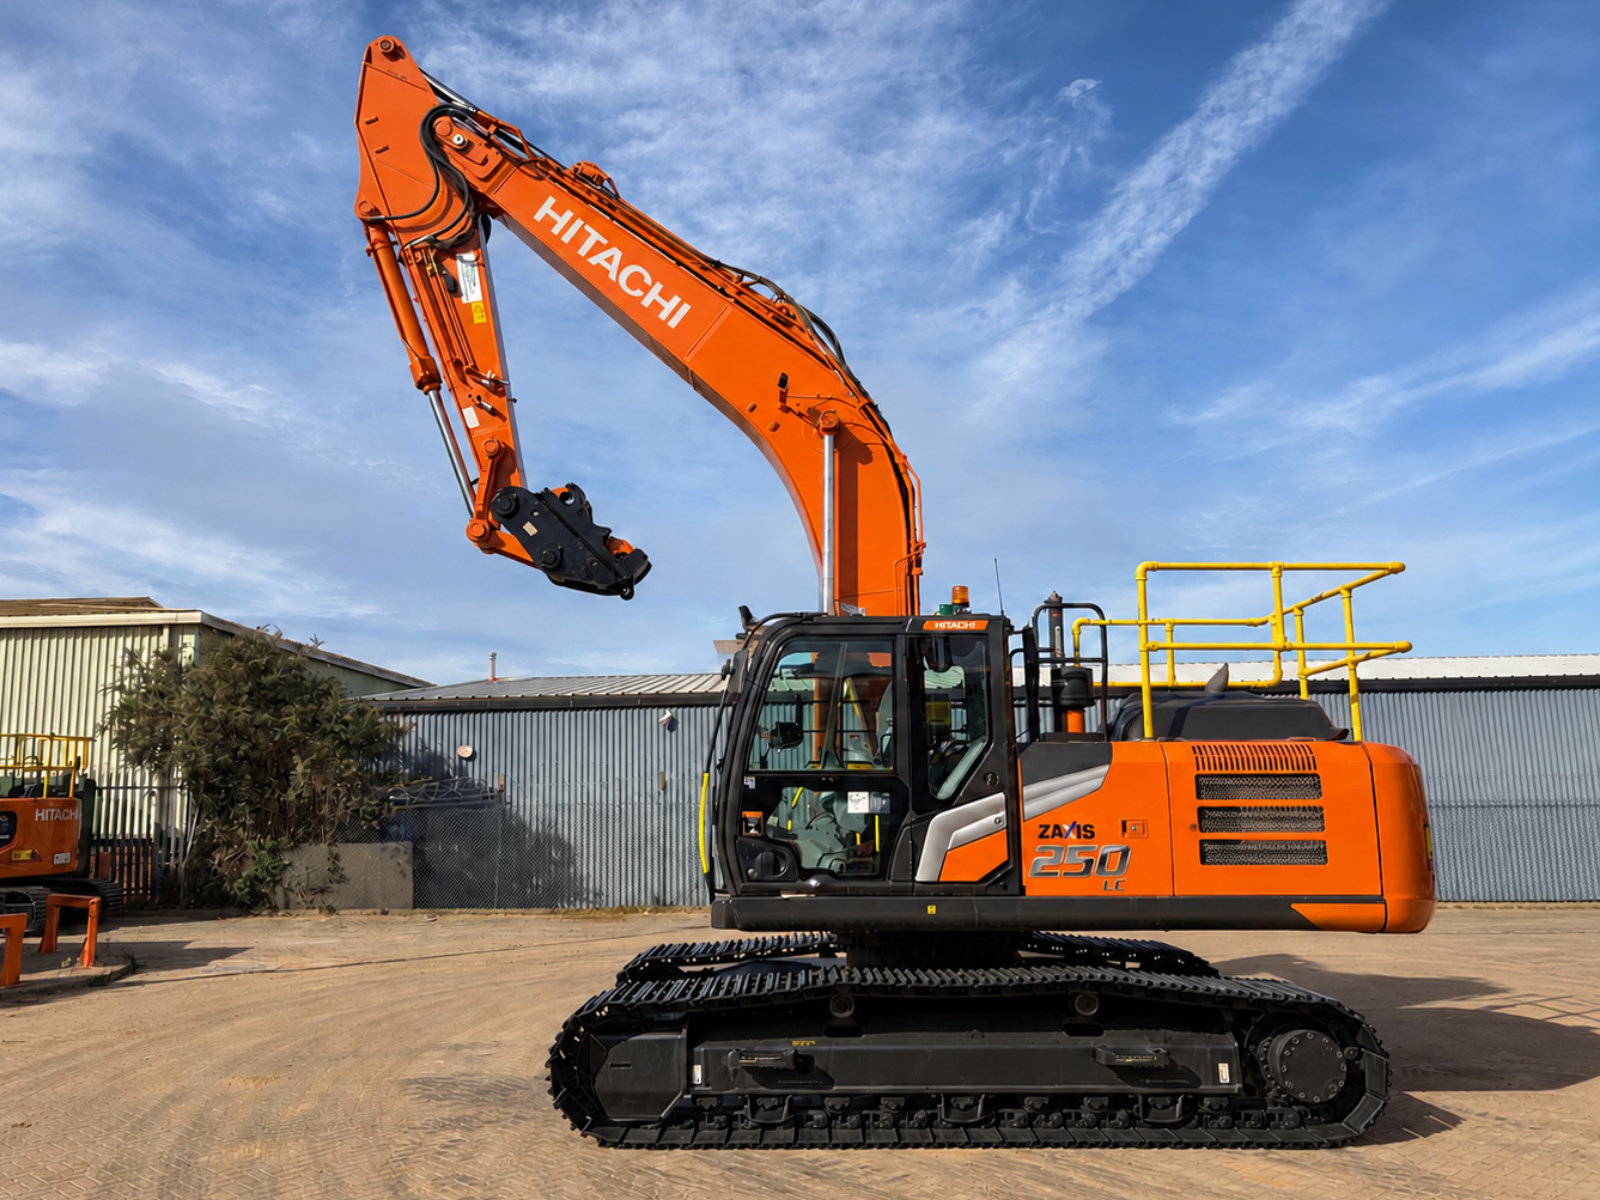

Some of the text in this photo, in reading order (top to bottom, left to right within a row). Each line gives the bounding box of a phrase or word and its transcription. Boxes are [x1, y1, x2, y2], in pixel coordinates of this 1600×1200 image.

[533, 195, 692, 329] HITACHI
[935, 621, 976, 630] HITACHI
[35, 808, 81, 821] HITACH
[1038, 821, 1095, 839] ZAXIS
[1028, 844, 1132, 878] 250
[1103, 878, 1127, 891] LC
